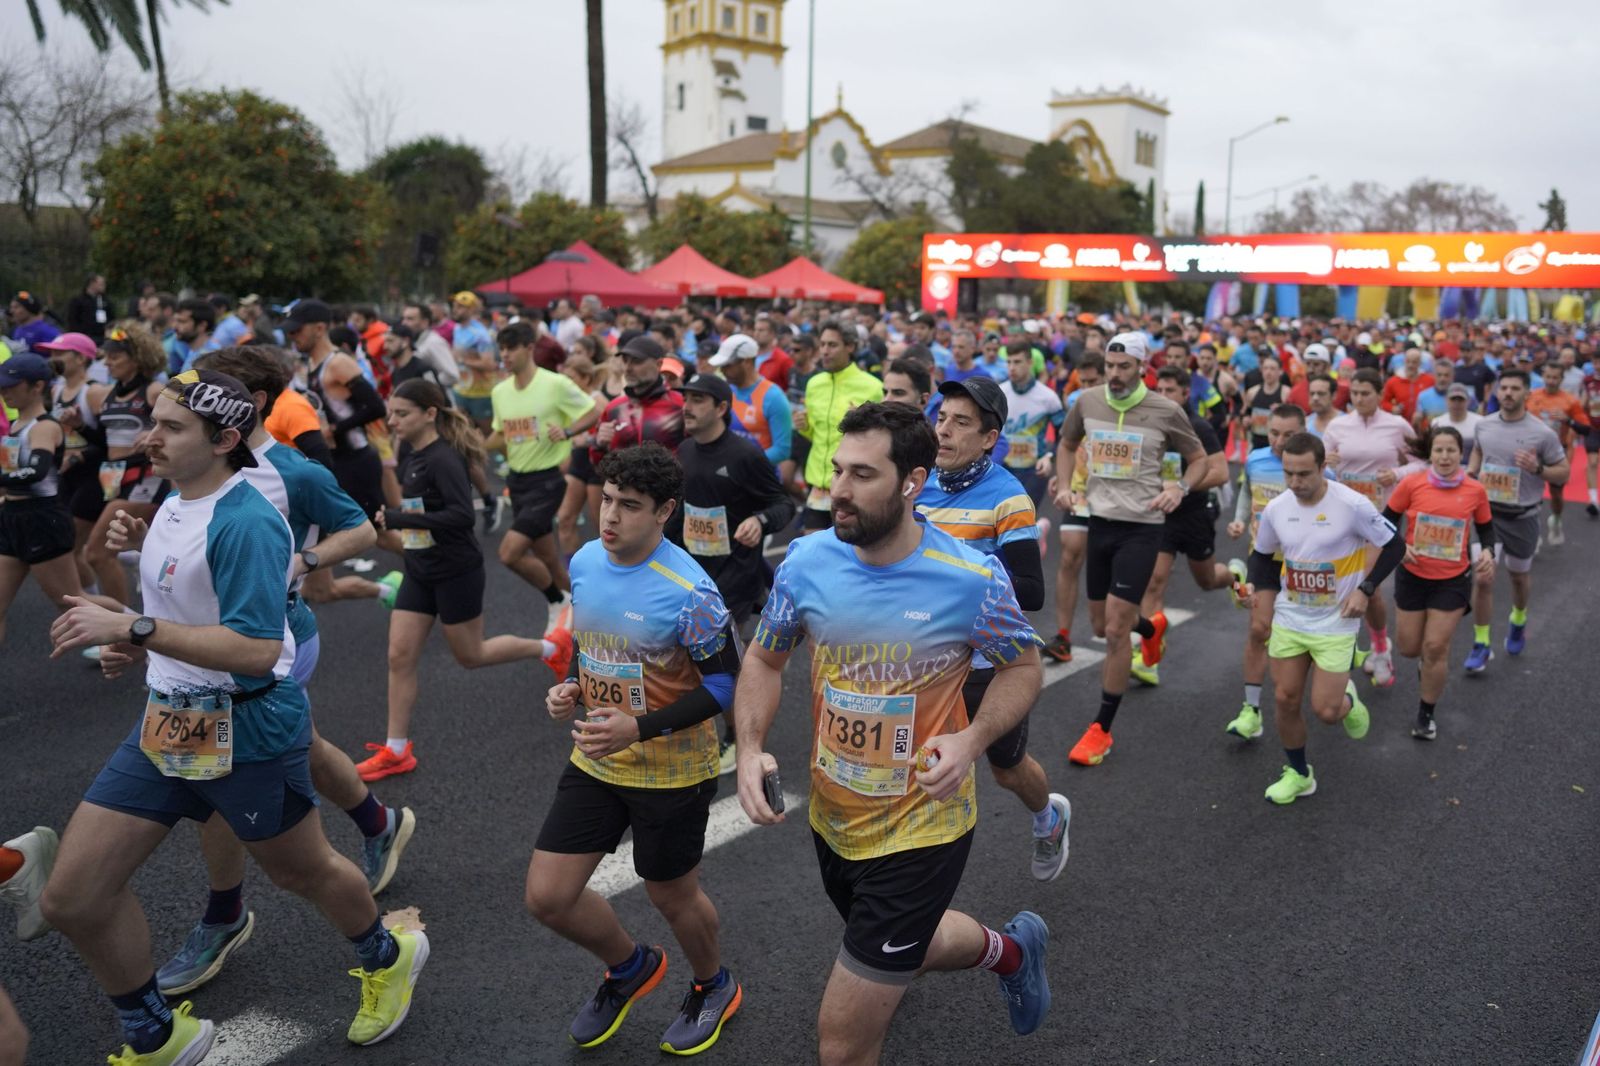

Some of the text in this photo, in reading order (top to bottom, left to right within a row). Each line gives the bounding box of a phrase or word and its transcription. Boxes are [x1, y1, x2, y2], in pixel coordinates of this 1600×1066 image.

[1099, 442, 1129, 458] 7859
[1423, 524, 1454, 541] 7317
[1292, 571, 1326, 589] 1106
[903, 610, 931, 621] HOKA
[821, 641, 913, 664] MEDIO
[583, 672, 623, 704] 7326
[155, 710, 208, 742] 7964
[826, 708, 883, 751] 7381
